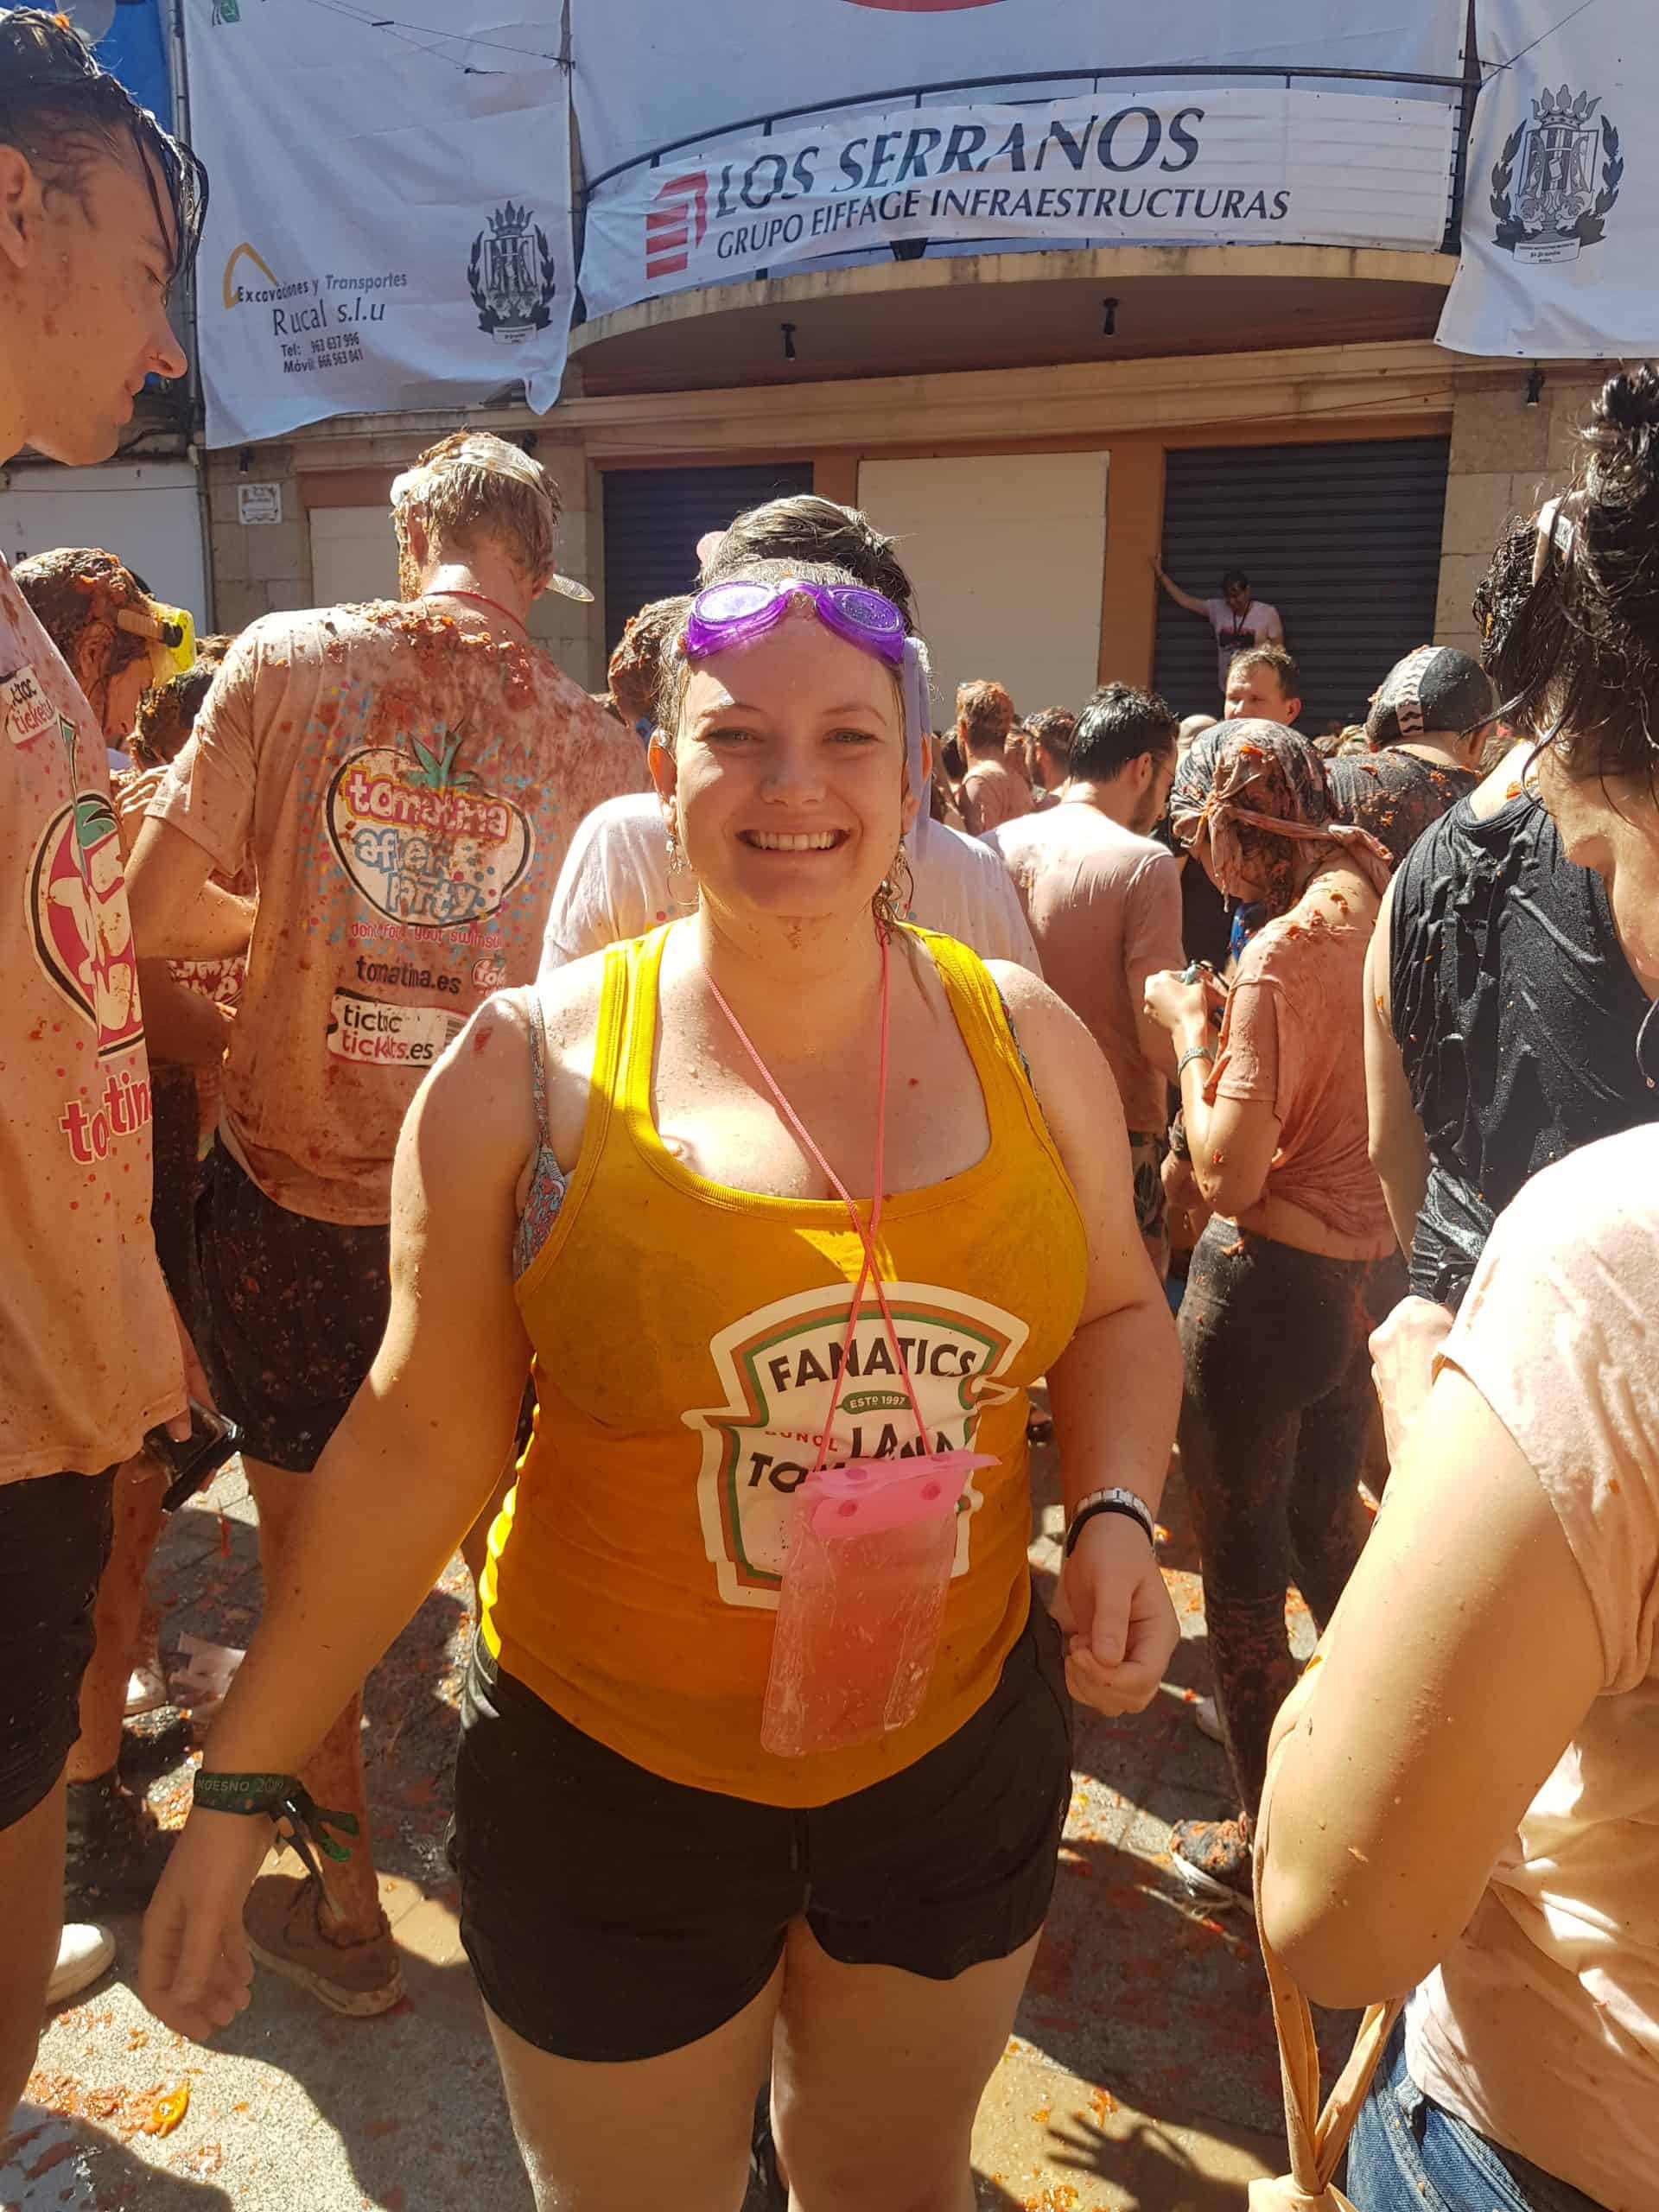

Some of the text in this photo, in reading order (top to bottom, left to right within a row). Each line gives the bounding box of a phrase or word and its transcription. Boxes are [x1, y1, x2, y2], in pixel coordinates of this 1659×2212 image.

[715, 106, 1205, 218] LOS SERRANOS
[717, 188, 1291, 259] GRUPO EIFFAGE INFRAESTRUCTURAS
[313, 279, 319, 296] y
[326, 271, 407, 294] Transportes
[273, 299, 327, 336] Rucal
[281, 344, 302, 357] Tel:
[344, 1004, 403, 1033] tictc
[768, 1337, 976, 1393] FANATICS
[882, 1395, 906, 1406] 1997
